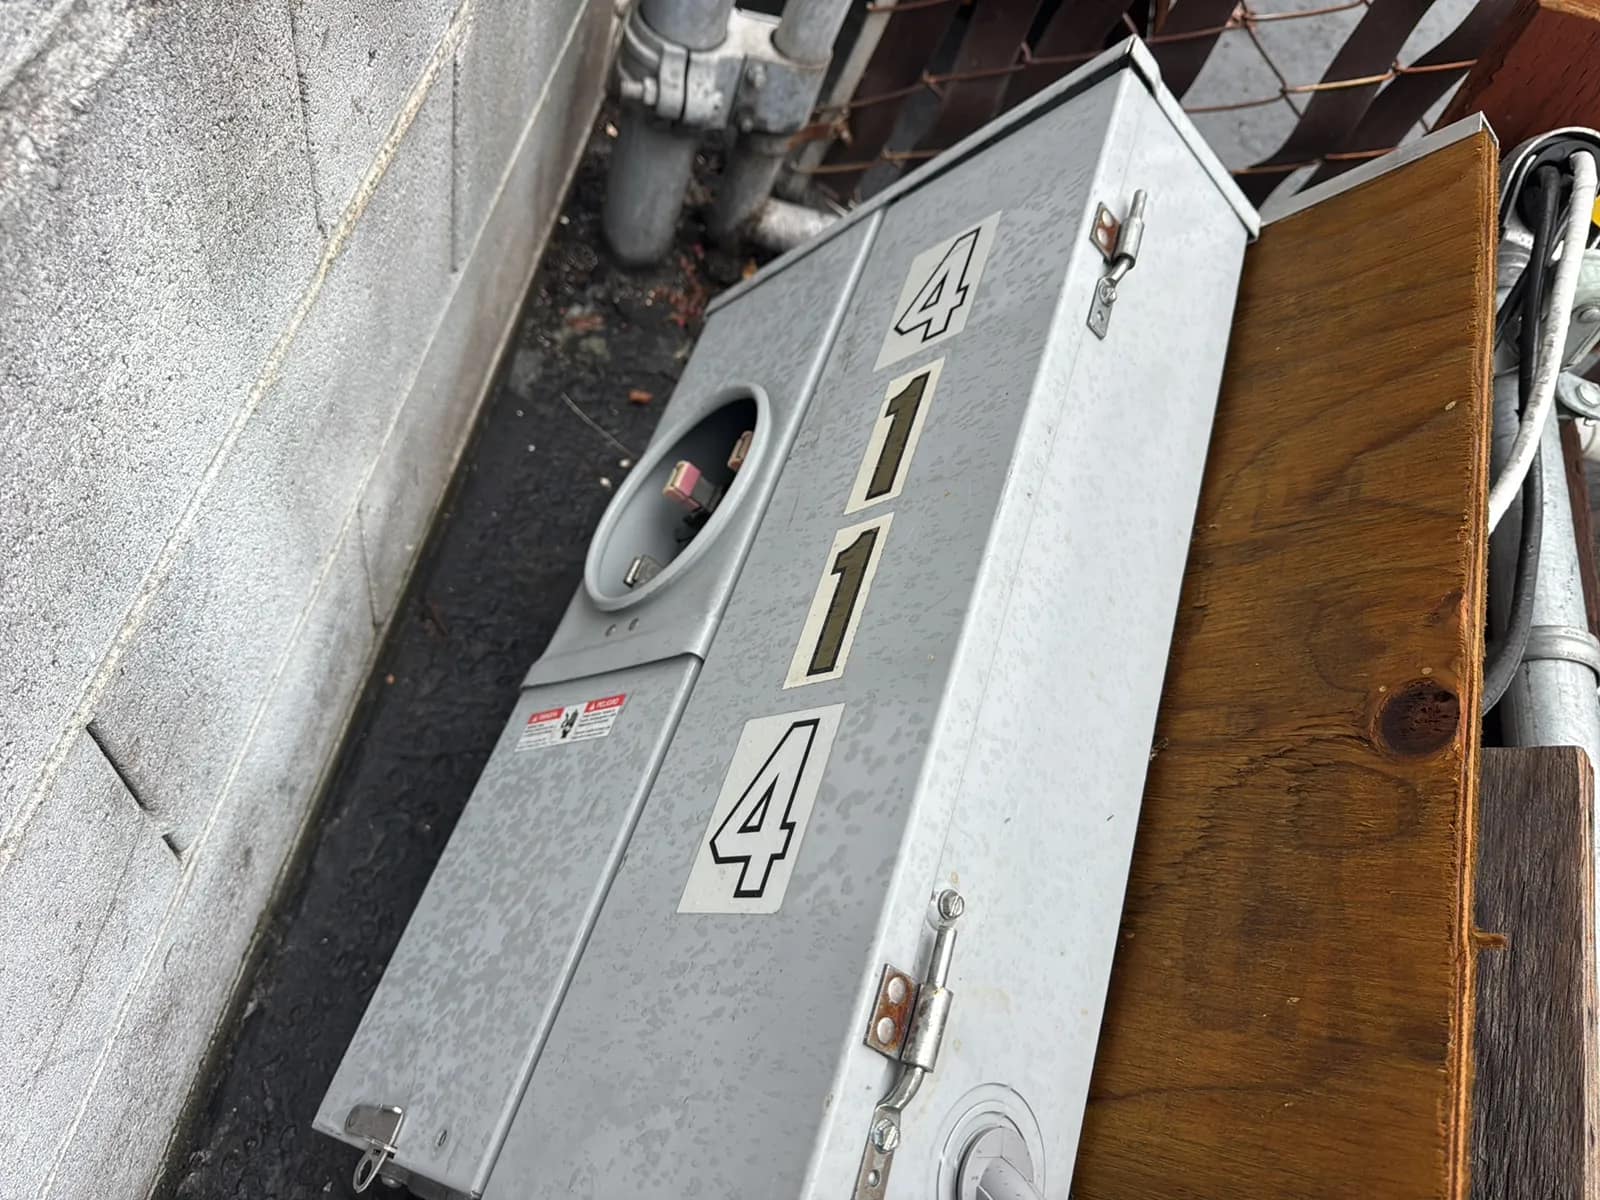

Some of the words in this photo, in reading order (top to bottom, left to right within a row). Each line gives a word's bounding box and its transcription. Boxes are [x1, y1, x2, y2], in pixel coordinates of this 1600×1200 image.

[894, 226, 981, 342] 4
[864, 371, 931, 501] 1
[806, 526, 881, 676] 1
[709, 718, 820, 898] 4
